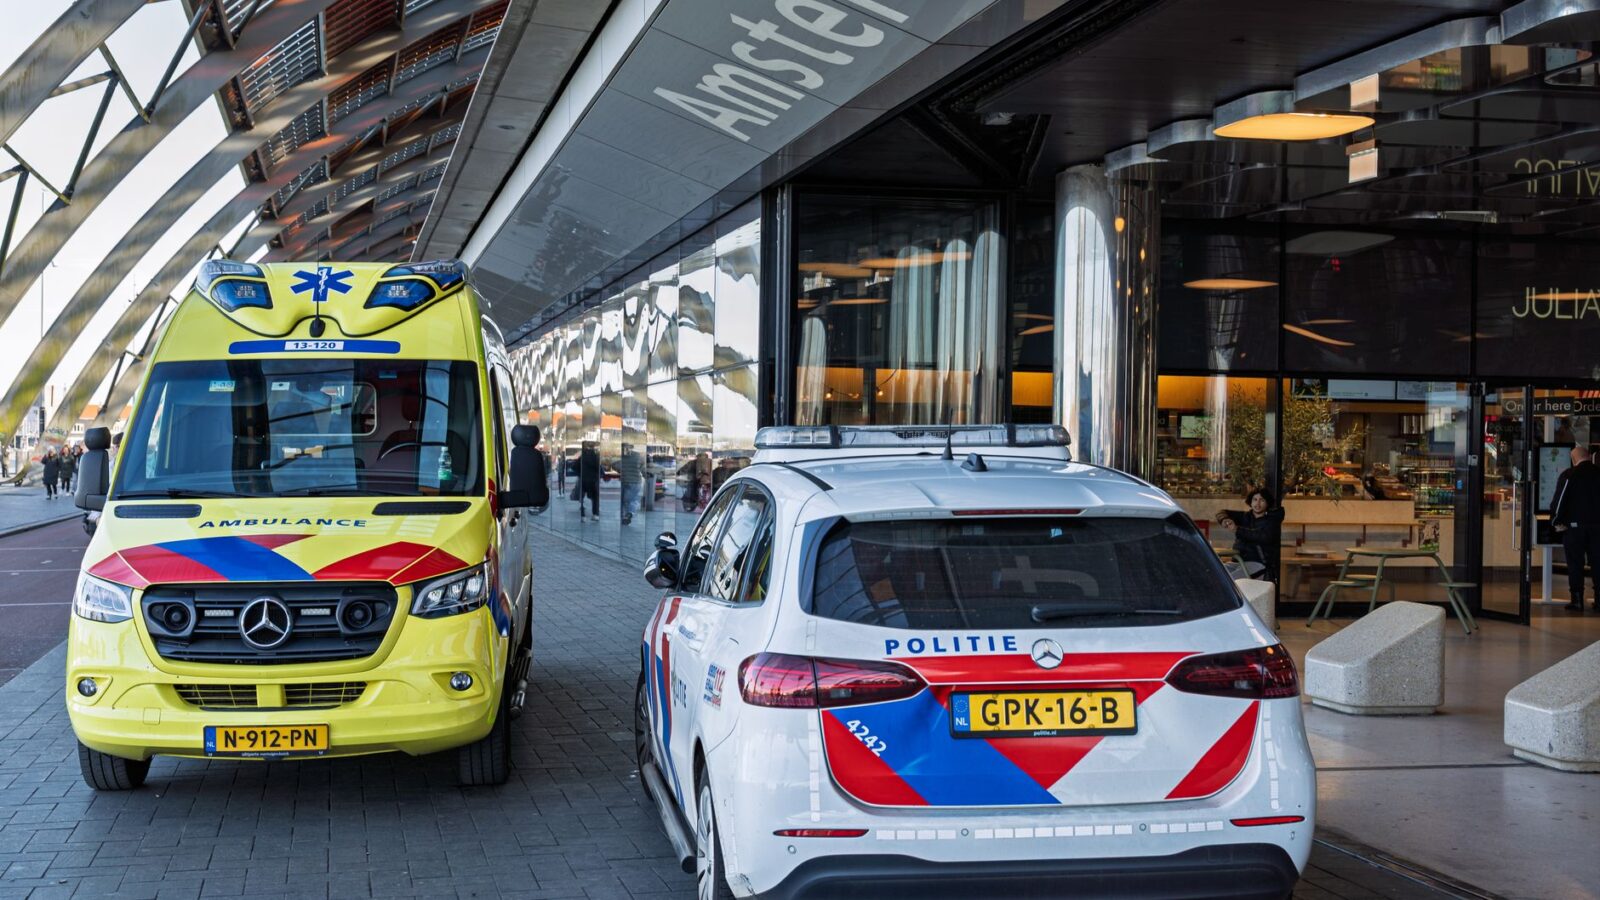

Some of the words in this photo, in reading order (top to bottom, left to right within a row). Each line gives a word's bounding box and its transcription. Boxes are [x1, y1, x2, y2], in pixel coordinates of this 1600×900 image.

[1512, 286, 1600, 319] JULIA
[1545, 398, 1571, 411] here
[199, 518, 367, 529] AMBULANCE
[884, 635, 1018, 655] POLITIE
[955, 717, 968, 726] NL
[981, 697, 1119, 727] GPK-16-B
[224, 728, 317, 749] N-912-PN
[846, 719, 887, 758] 4242
